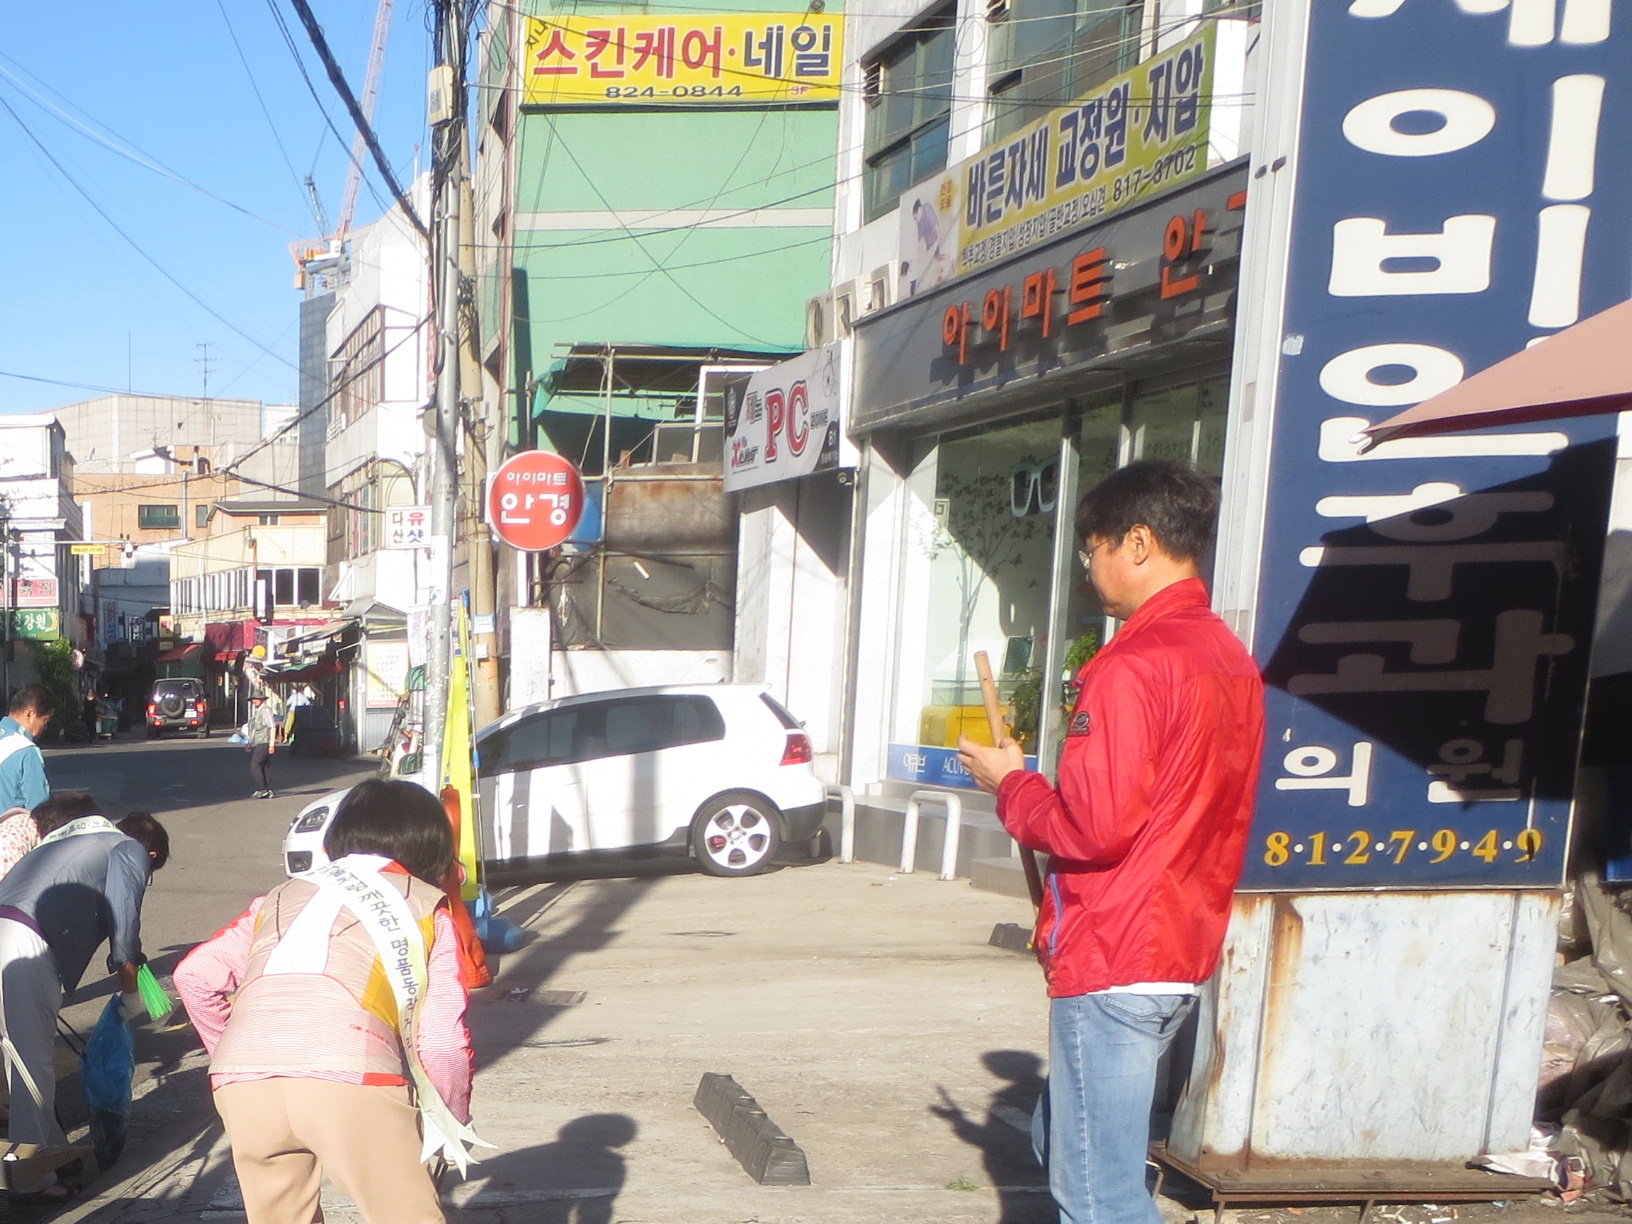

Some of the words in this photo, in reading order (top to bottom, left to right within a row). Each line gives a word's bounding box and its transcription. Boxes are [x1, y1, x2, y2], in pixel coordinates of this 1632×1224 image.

[605, 85, 744, 98] 824-0844
[967, 126, 1050, 229] 바른자세
[942, 246, 1106, 365] 아이마트
[765, 380, 810, 464] PC
[506, 471, 568, 487] 아이마트
[500, 493, 571, 526] 안경
[360, 889, 401, 933] 깨끗한
